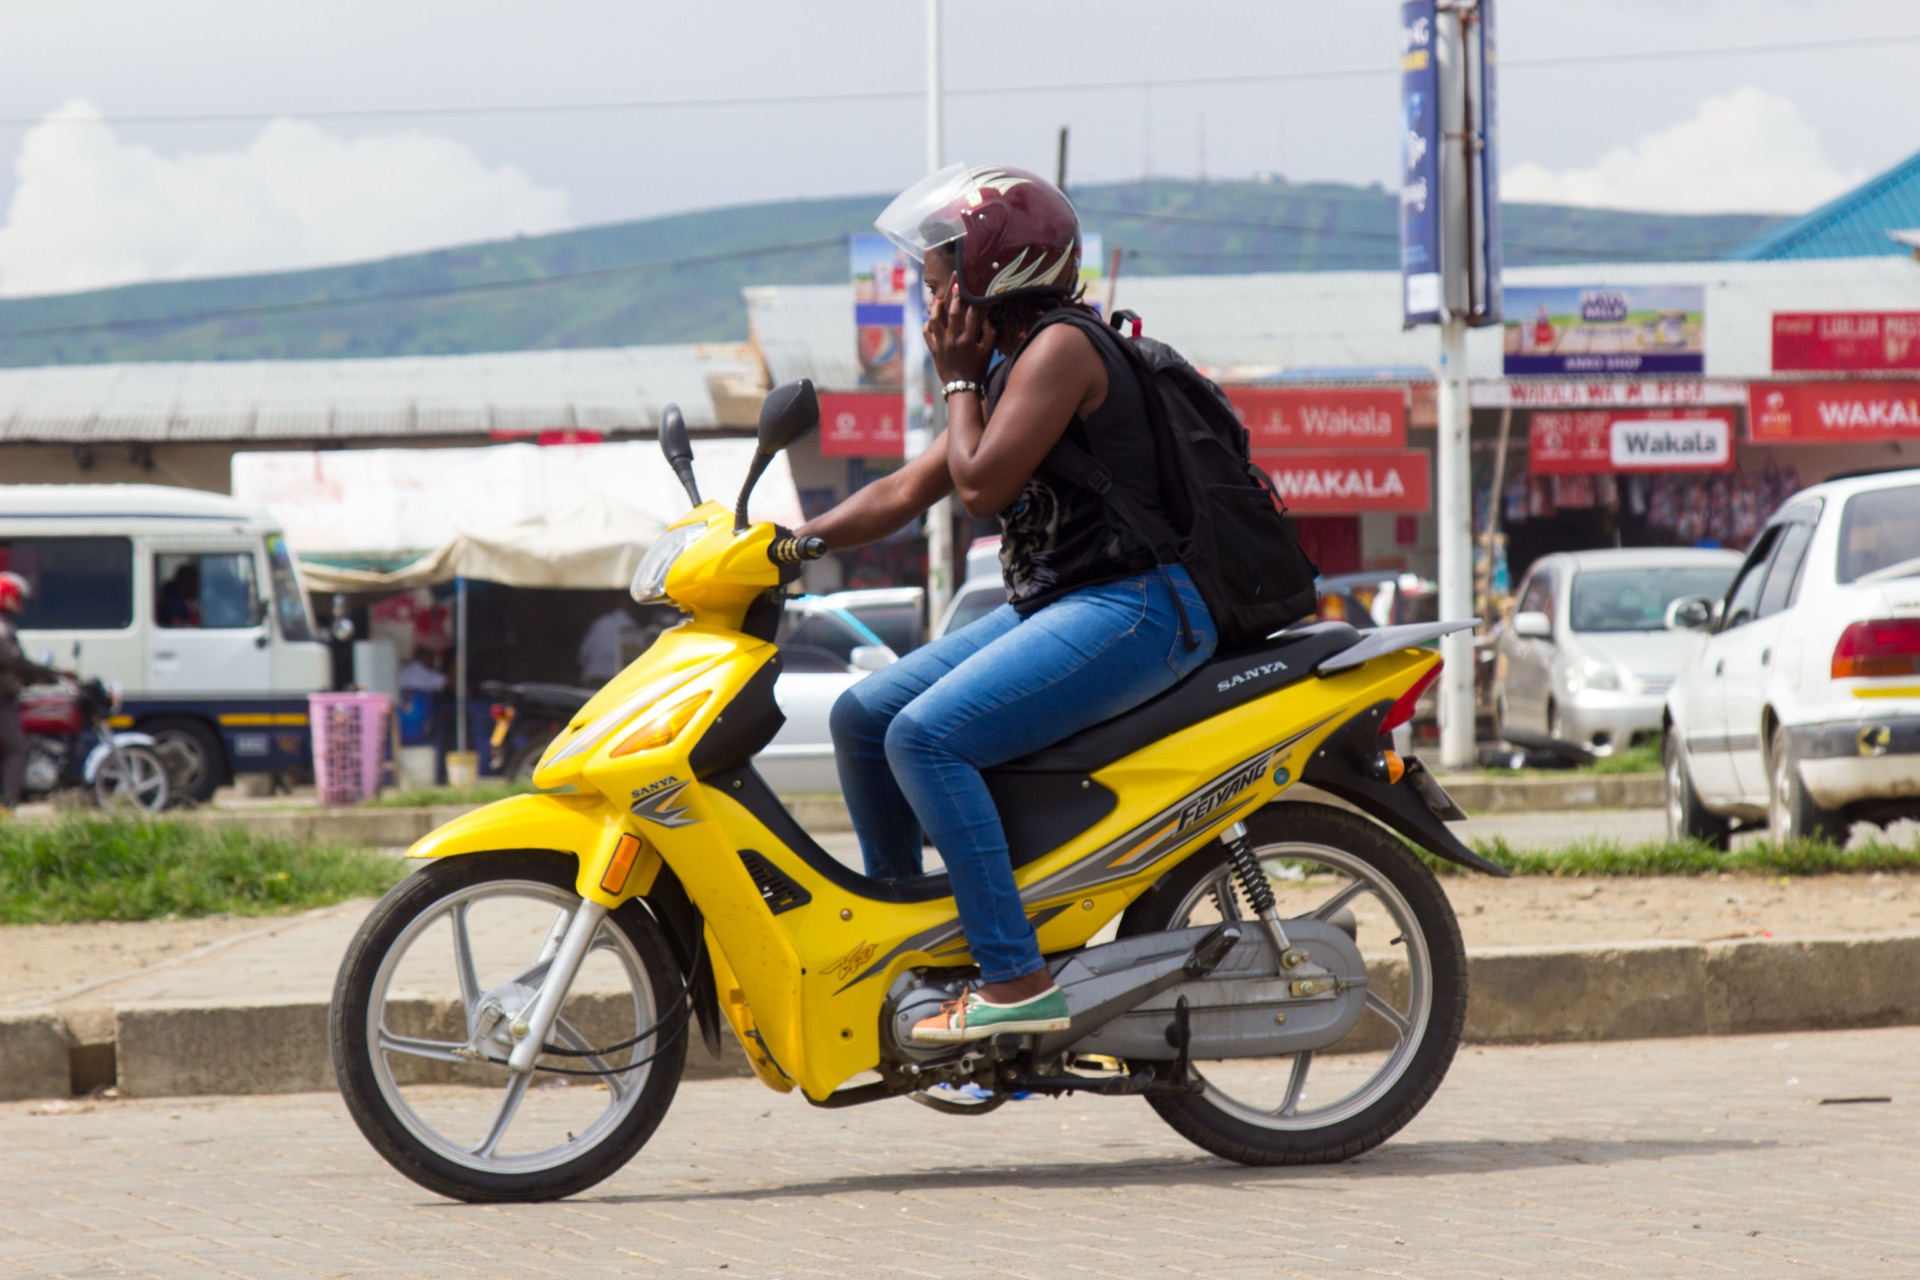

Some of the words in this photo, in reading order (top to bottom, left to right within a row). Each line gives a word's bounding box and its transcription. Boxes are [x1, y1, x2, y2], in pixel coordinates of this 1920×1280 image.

[1606, 355, 1641, 369] SHOP
[1510, 383, 1578, 404] WAKALA
[1587, 383, 1615, 403] WA
[1300, 405, 1392, 436] Wakala
[1624, 430, 1717, 453] Wakala
[1272, 468, 1404, 497] WAKALA
[1217, 660, 1289, 693] SANYA
[631, 775, 678, 799] SANYA
[1176, 760, 1269, 834] FEIYANG
